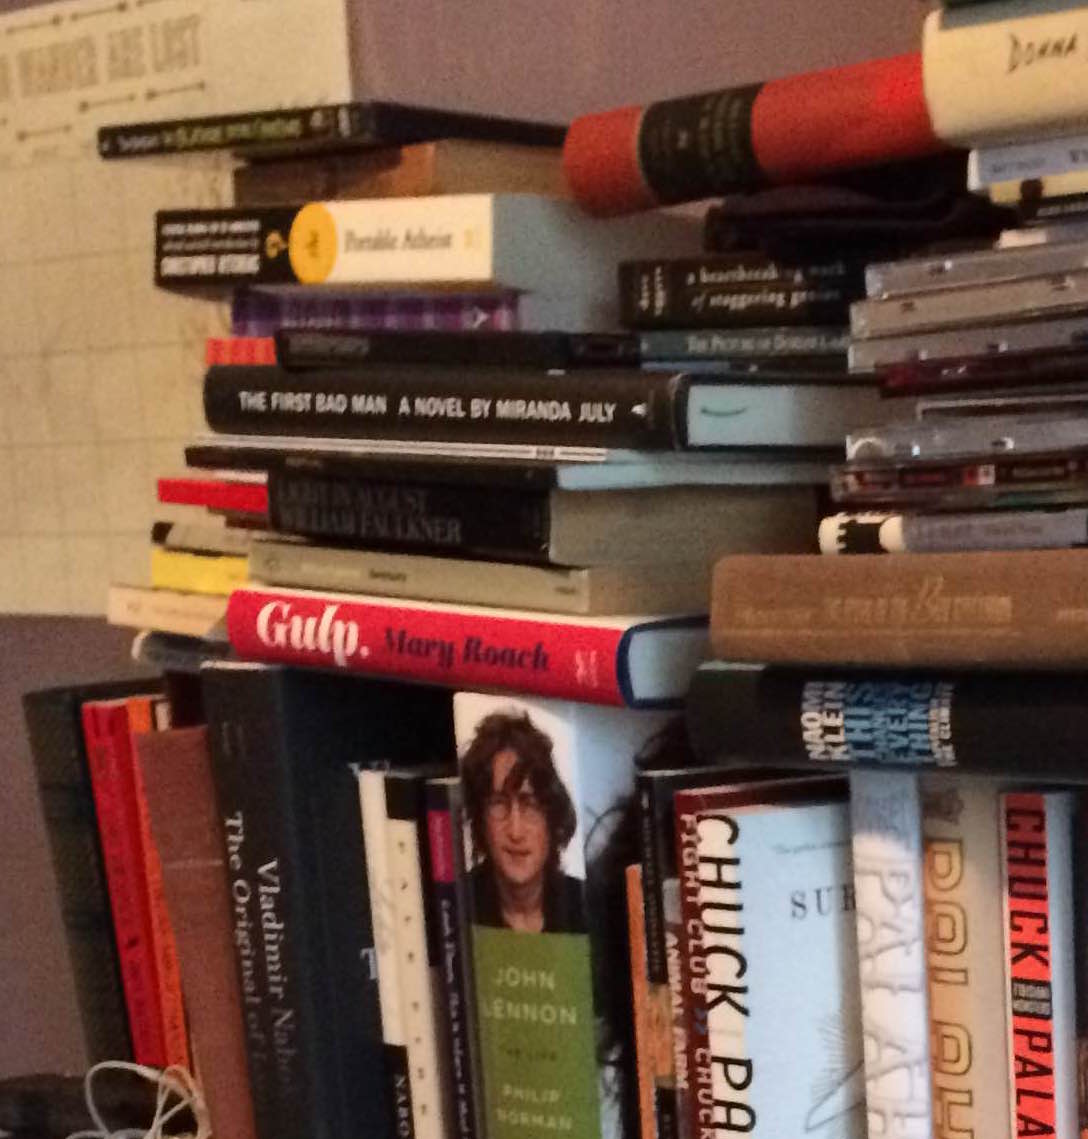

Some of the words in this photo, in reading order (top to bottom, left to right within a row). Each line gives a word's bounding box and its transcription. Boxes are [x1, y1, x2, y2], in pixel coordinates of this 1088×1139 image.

[1007, 33, 1077, 75] DONNA
[238, 390, 267, 412] THE
[270, 391, 312, 413] FIRST
[315, 393, 347, 415] BAD
[351, 394, 387, 415] MAN
[399, 397, 411, 416] A
[414, 397, 466, 419] NOVEL
[470, 398, 493, 419] BY
[496, 399, 572, 421] MIRANDA
[577, 401, 618, 423] JULY
[256, 600, 370, 668] Gulp.
[383, 627, 456, 669] Mary
[462, 636, 550, 672] Roach
[800, 681, 826, 761] NAOMI
[822, 681, 851, 761] KLEIN
[223, 811, 248, 871] The
[678, 814, 701, 903] FIGHT
[697, 815, 752, 1018] CHUCK
[1003, 803, 1054, 974] CHUCK
[232, 877, 264, 1006] Original
[256, 857, 289, 1002] Vladimir
[687, 917, 709, 995] CLUB
[497, 966, 557, 996] JOHN
[663, 931, 687, 1018] ANIMAL
[483, 997, 578, 1028] LENNON
[502, 1085, 562, 1105] PHILIP
[671, 1026, 690, 1090] FARM
[496, 1108, 573, 1131] NORMAN
